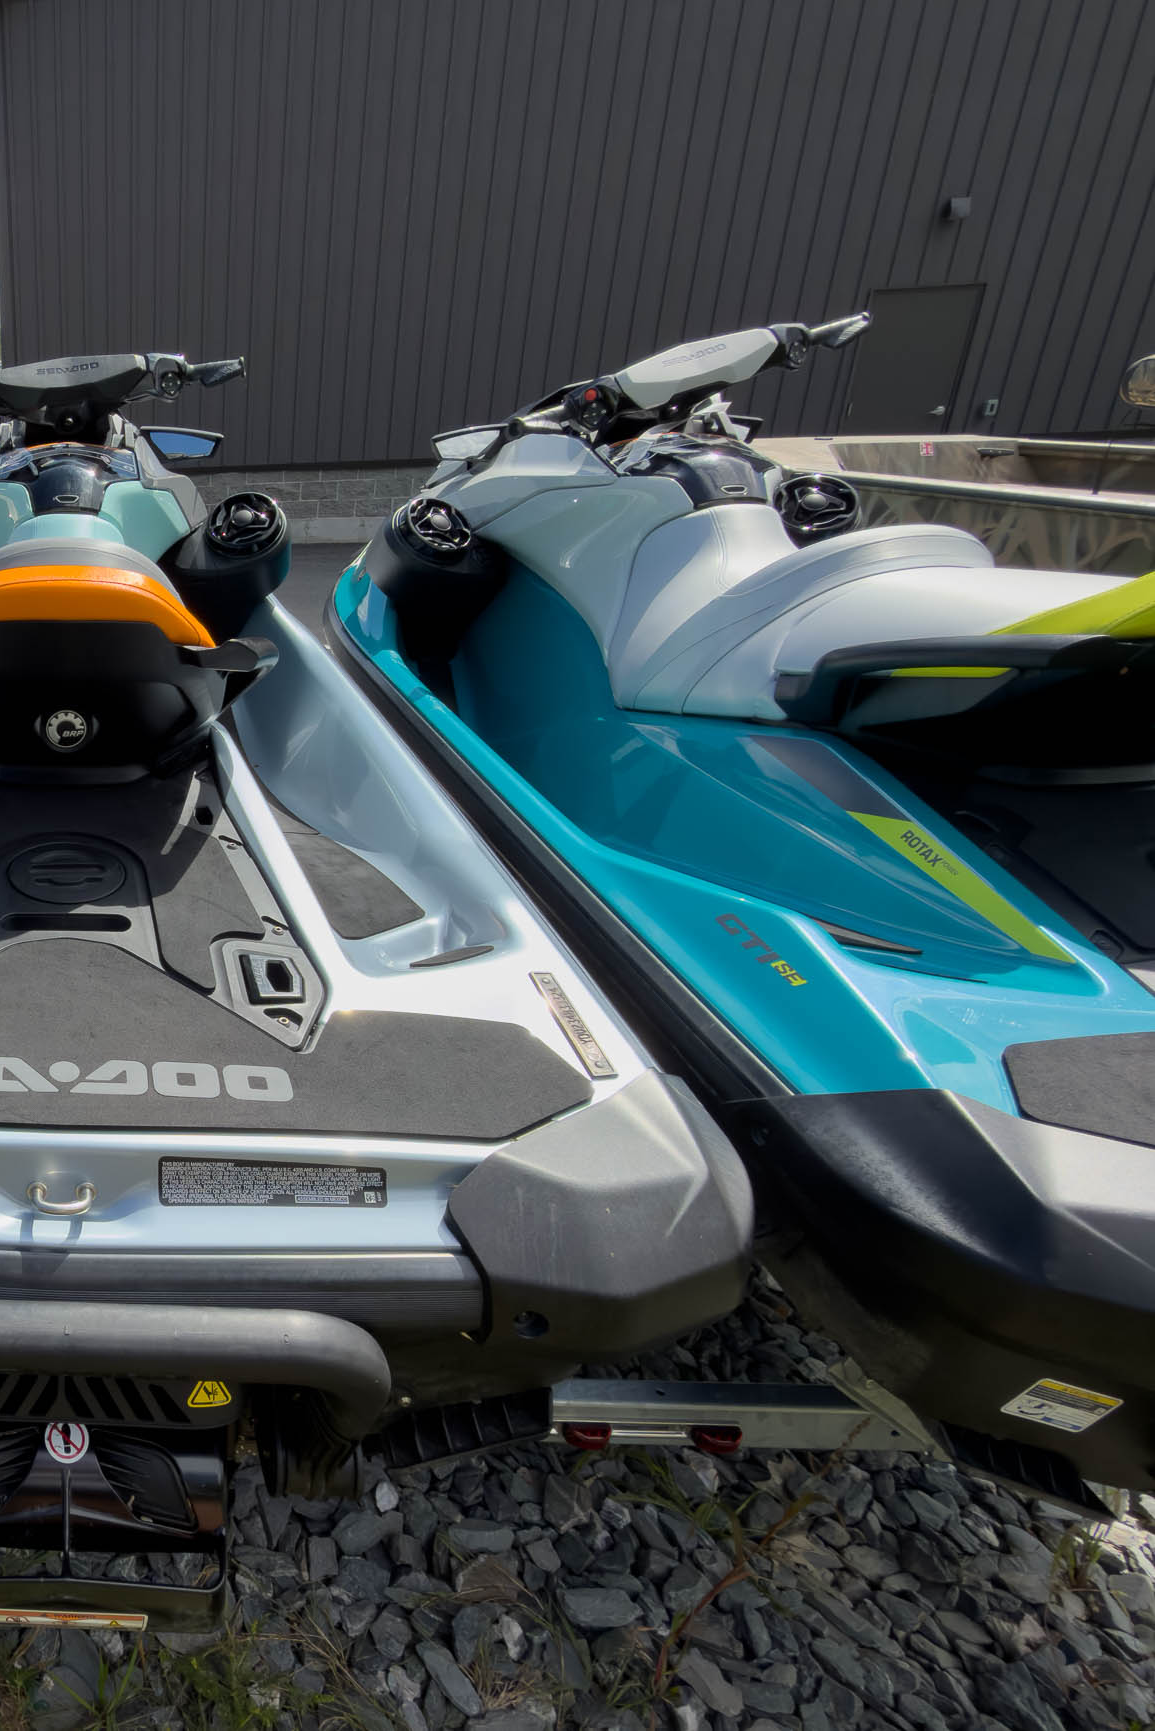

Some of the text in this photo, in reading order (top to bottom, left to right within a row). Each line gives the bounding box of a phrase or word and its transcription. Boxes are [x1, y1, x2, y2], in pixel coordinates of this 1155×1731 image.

[62, 730, 85, 738] BRP
[900, 830, 943, 868] ROTAX
[715, 913, 781, 964] GTI
